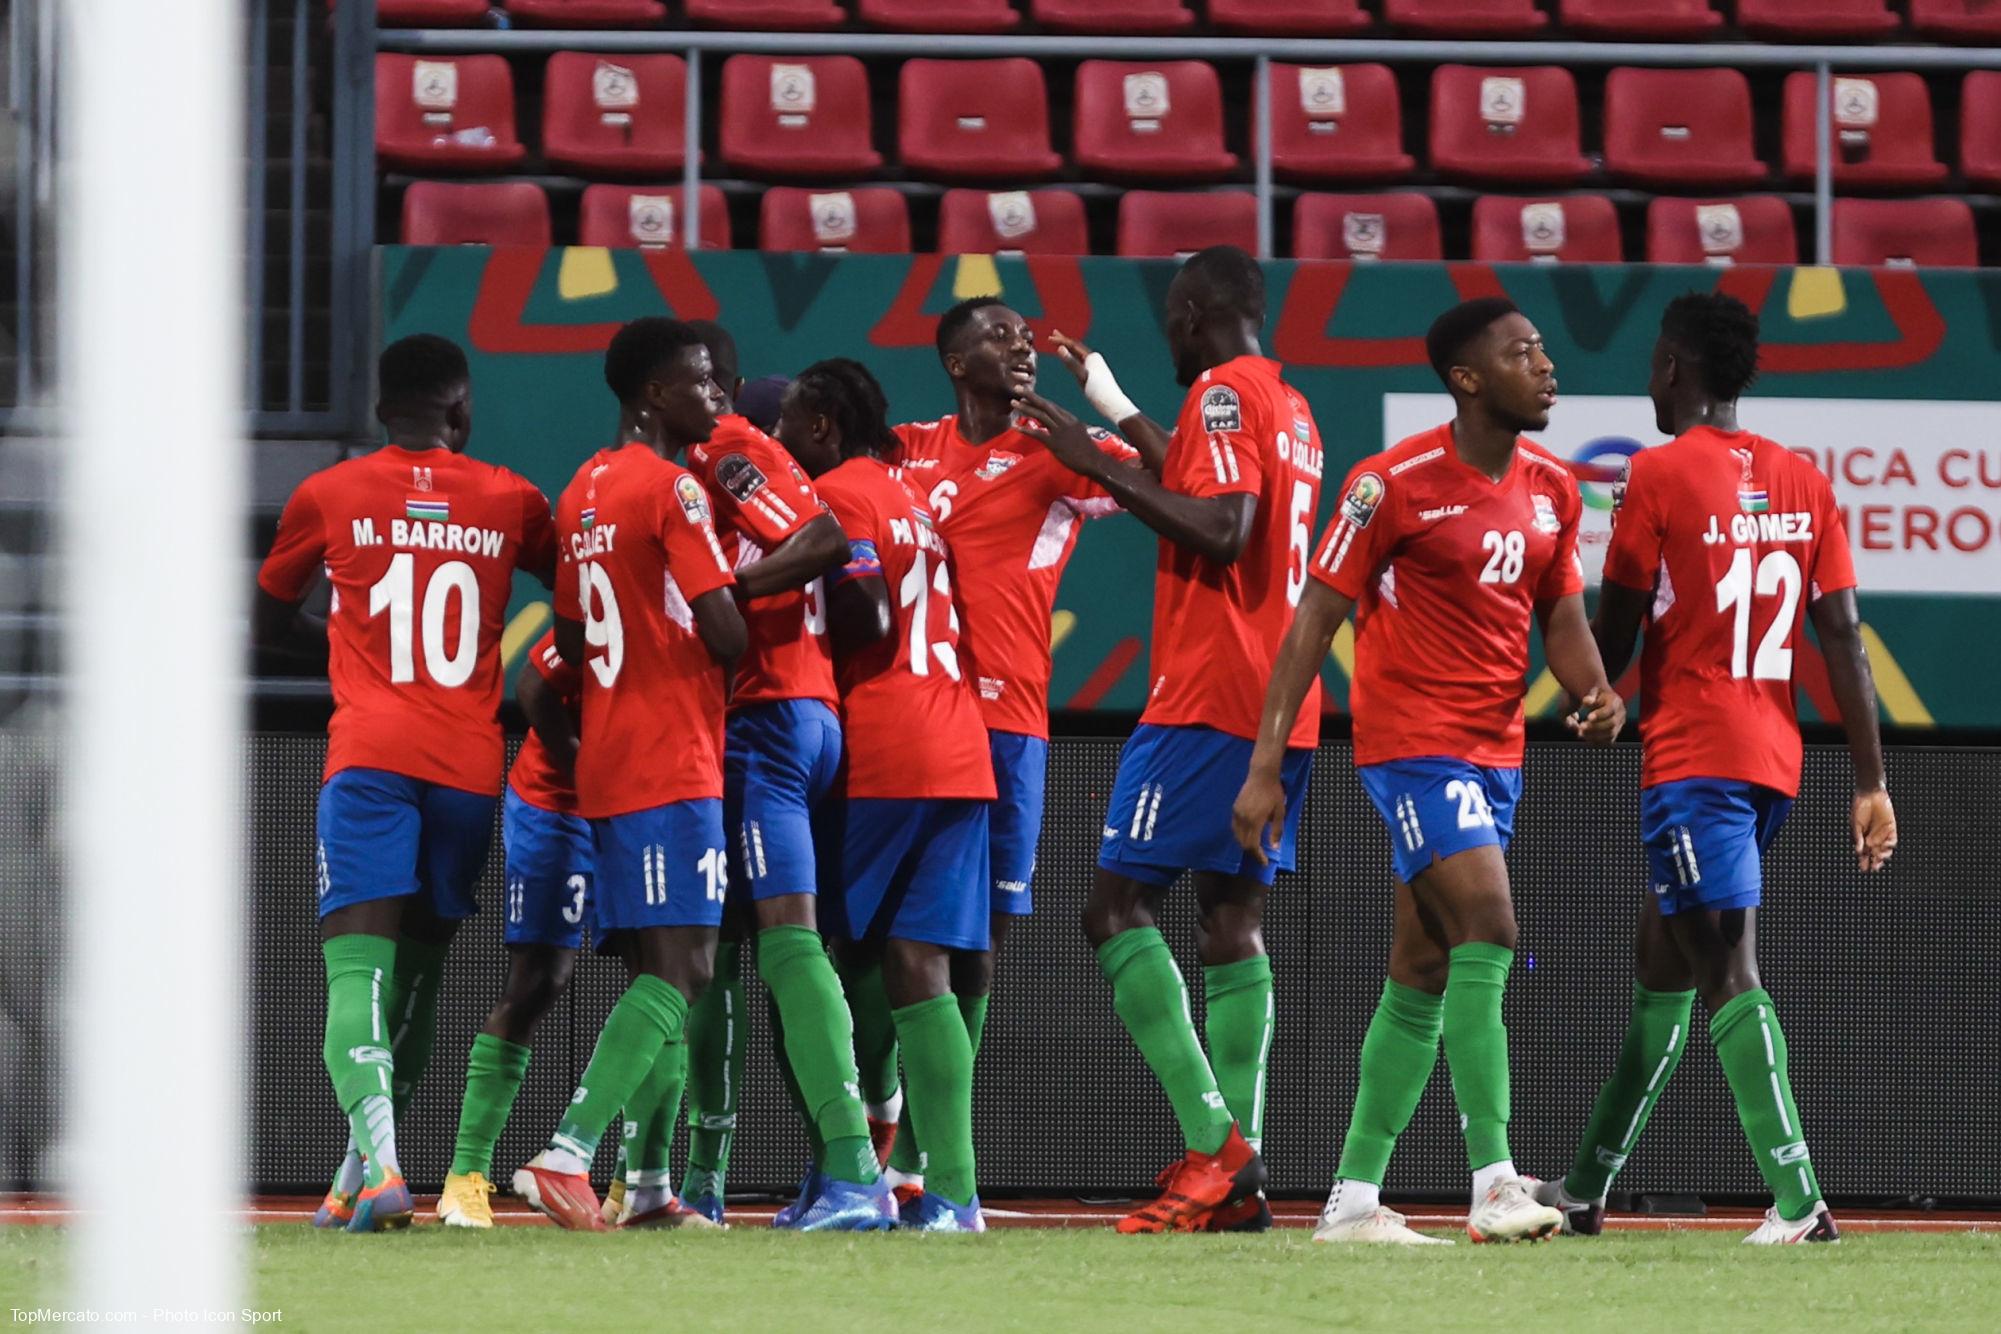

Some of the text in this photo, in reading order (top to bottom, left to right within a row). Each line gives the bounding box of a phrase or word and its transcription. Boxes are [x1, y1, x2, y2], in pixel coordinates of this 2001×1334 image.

[352, 517, 504, 557] M. BARROW
[1287, 479, 1313, 608] 5
[1703, 511, 1813, 545] J. GOMEZ
[1478, 530, 1526, 585] 28
[369, 552, 480, 688] 10
[1715, 547, 1802, 682] 12
[562, 873, 587, 924] 3
